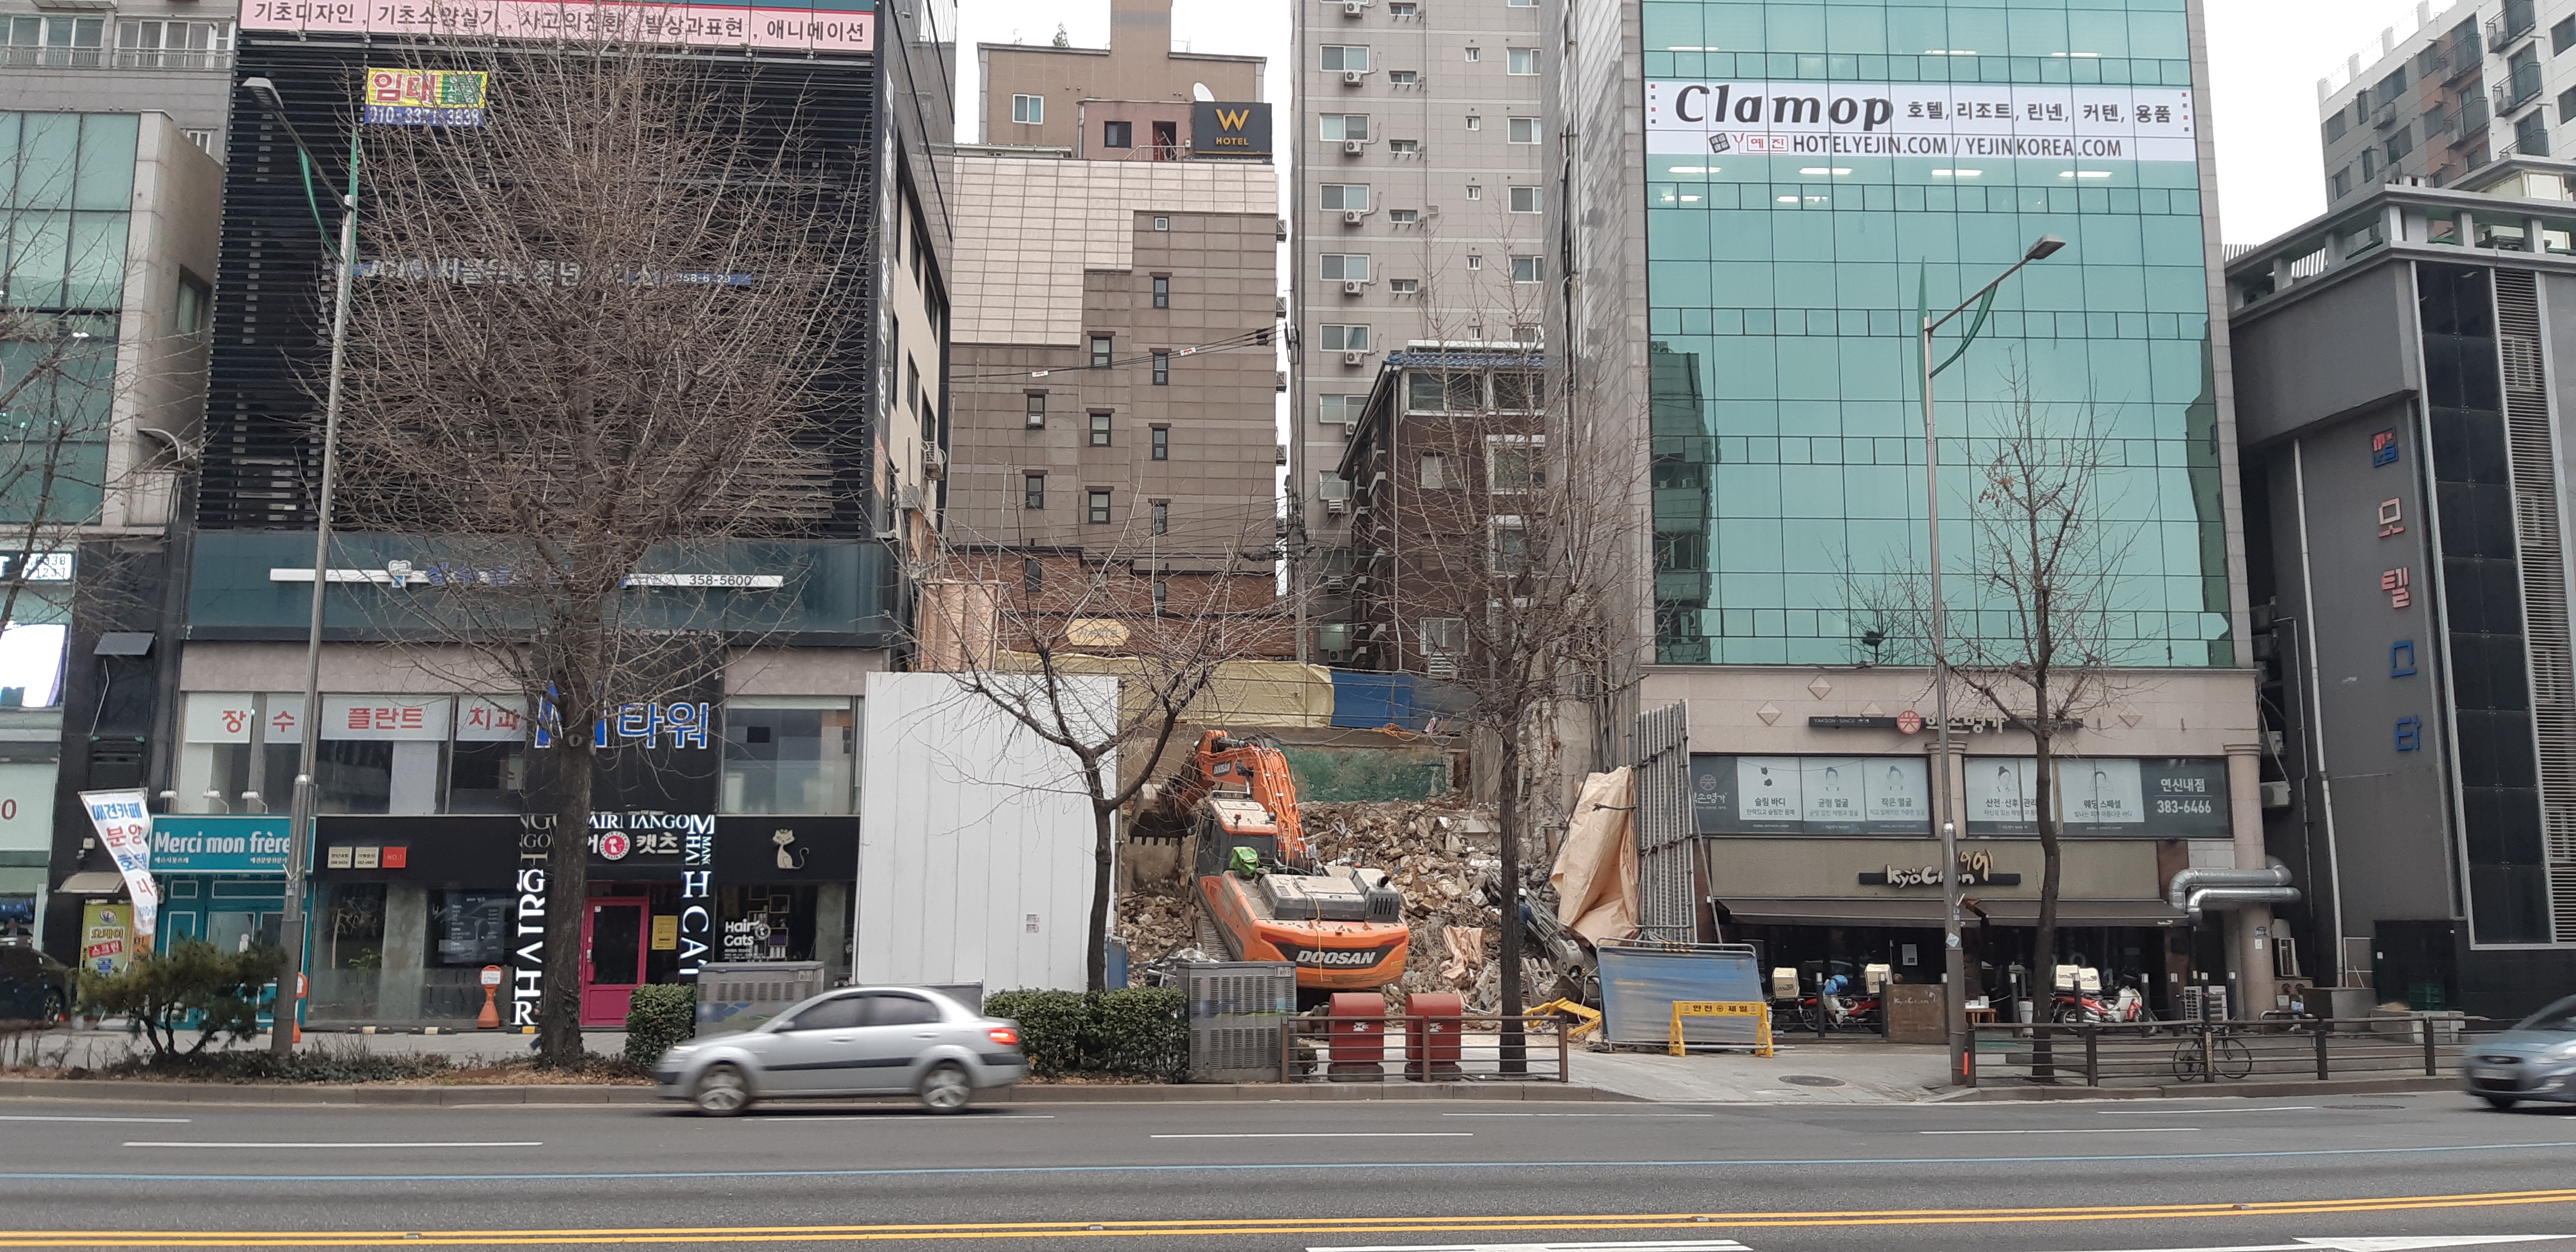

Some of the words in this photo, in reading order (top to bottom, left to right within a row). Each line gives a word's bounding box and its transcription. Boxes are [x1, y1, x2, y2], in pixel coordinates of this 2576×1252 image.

[768, 20, 864, 42] 애니메이션
[372, 72, 437, 104] 임대
[1675, 84, 1894, 132] Clamop
[1907, 101, 1950, 121] 호텔,
[2135, 105, 2171, 124] 용품
[1216, 108, 1250, 132] W
[1216, 137, 1249, 146] HOTEL
[1793, 135, 1947, 155] HOTELYEJIN.COM
[1966, 137, 2122, 157] YEJINKOREA.COM
[689, 575, 753, 586] 358-5600
[348, 707, 423, 730] 플란트
[469, 708, 519, 731] 치과
[1213, 762, 1230, 775] DOOSAN
[2161, 778, 2205, 793] 연신내점
[1771, 797, 1786, 807] 바디
[1881, 798, 1896, 807] 작은
[1898, 798, 1912, 807] 얼굴
[2157, 800, 2212, 814] 383-6466
[92, 802, 143, 821] 애견카페
[106, 823, 143, 847] 분양
[154, 831, 203, 853] Merci
[206, 836, 245, 853] mon
[249, 830, 291, 854] frère
[636, 831, 680, 855] 캣츠
[725, 918, 760, 933] Hair
[723, 934, 754, 947] Cats
[1295, 950, 1377, 965] DOOSAN
